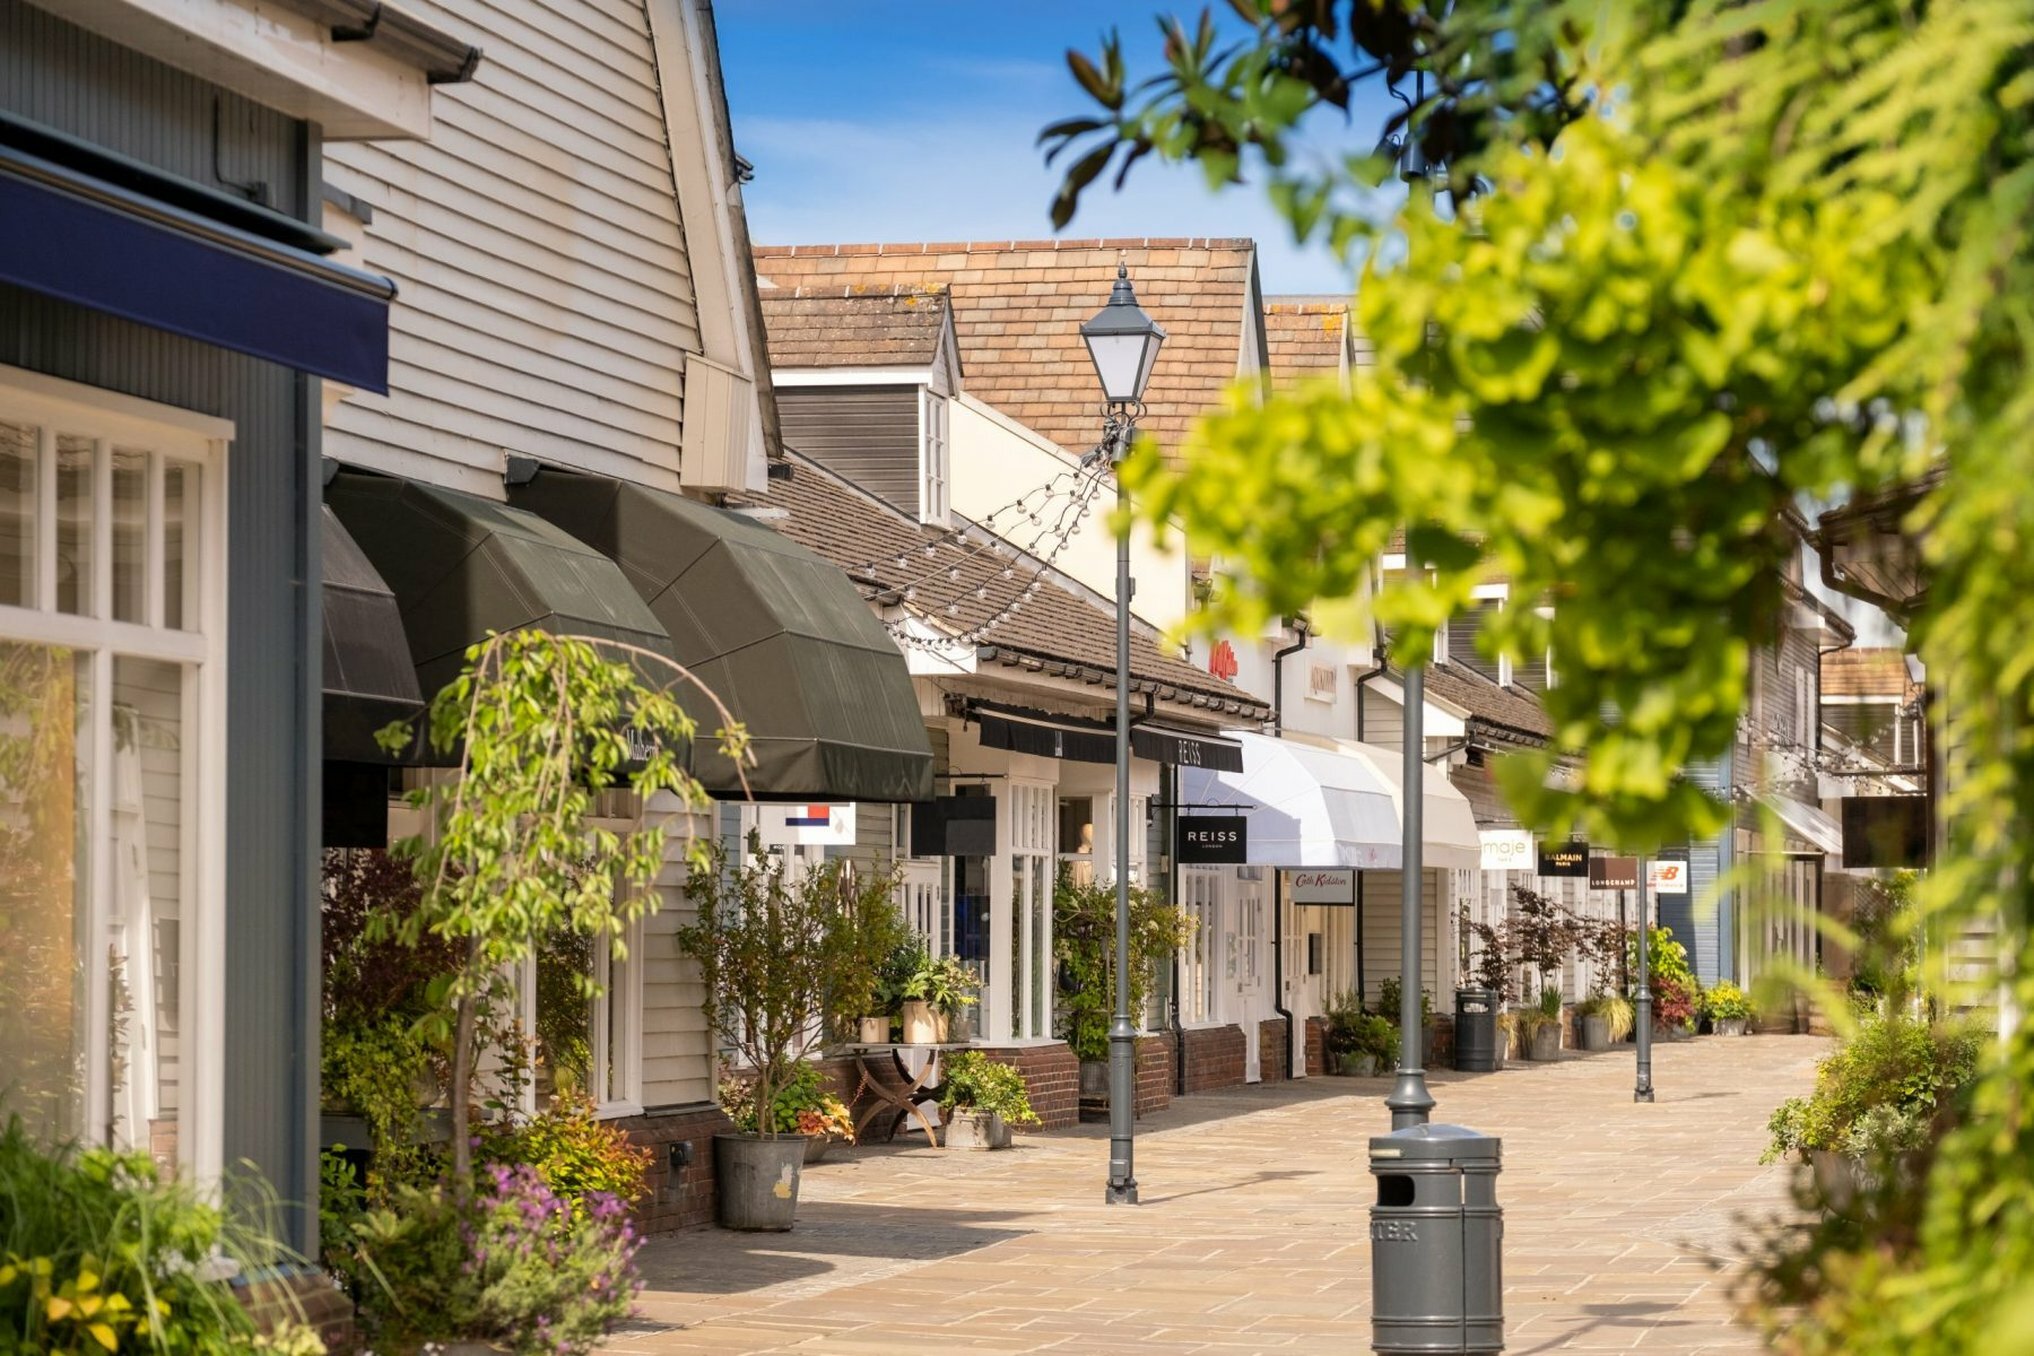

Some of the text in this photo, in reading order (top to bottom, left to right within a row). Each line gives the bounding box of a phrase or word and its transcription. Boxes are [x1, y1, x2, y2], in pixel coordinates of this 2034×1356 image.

[1178, 739, 1201, 766] REISS
[1187, 831, 1237, 842] REISS
[1483, 840, 1525, 856] maje
[1544, 853, 1582, 861] BALMAIN
[1295, 873, 1346, 888] Cath Kidston
